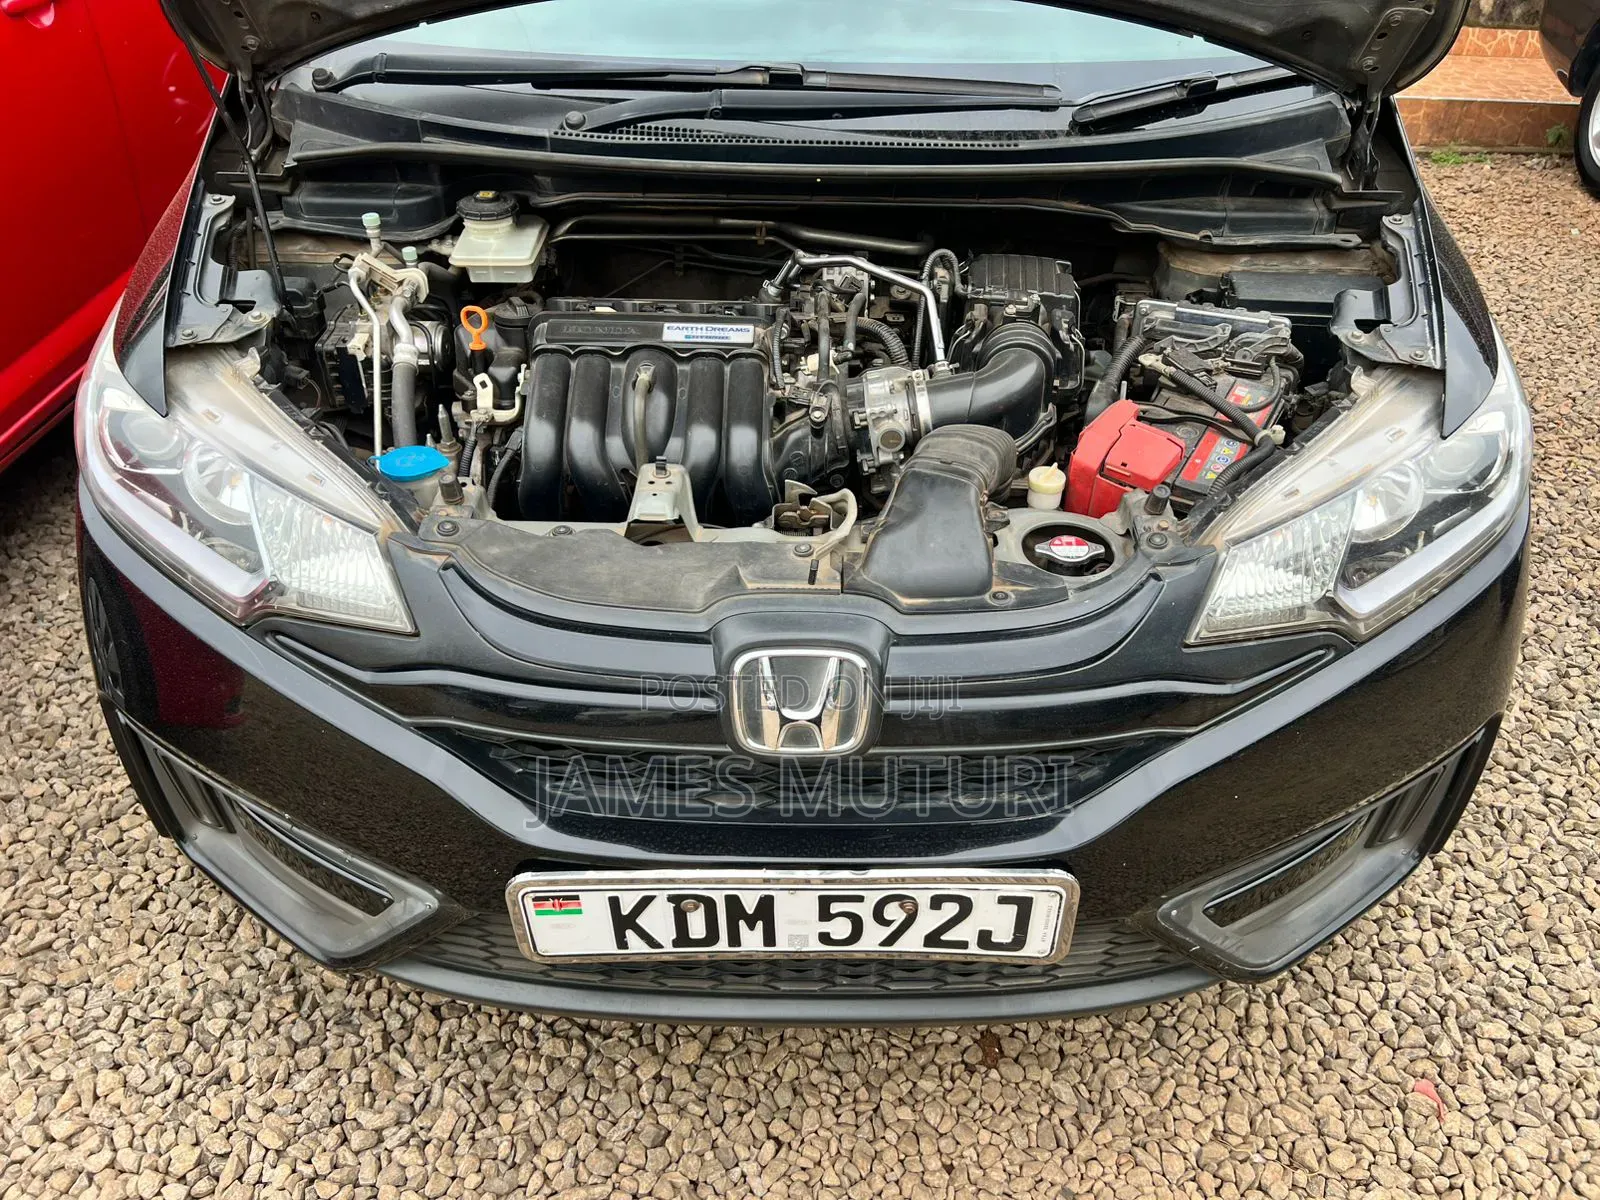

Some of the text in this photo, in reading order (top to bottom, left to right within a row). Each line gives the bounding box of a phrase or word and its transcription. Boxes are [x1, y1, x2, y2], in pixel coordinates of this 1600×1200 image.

[705, 325, 751, 333] DREAMS
[607, 893, 777, 950] KDM
[817, 893, 1035, 952] 592J
